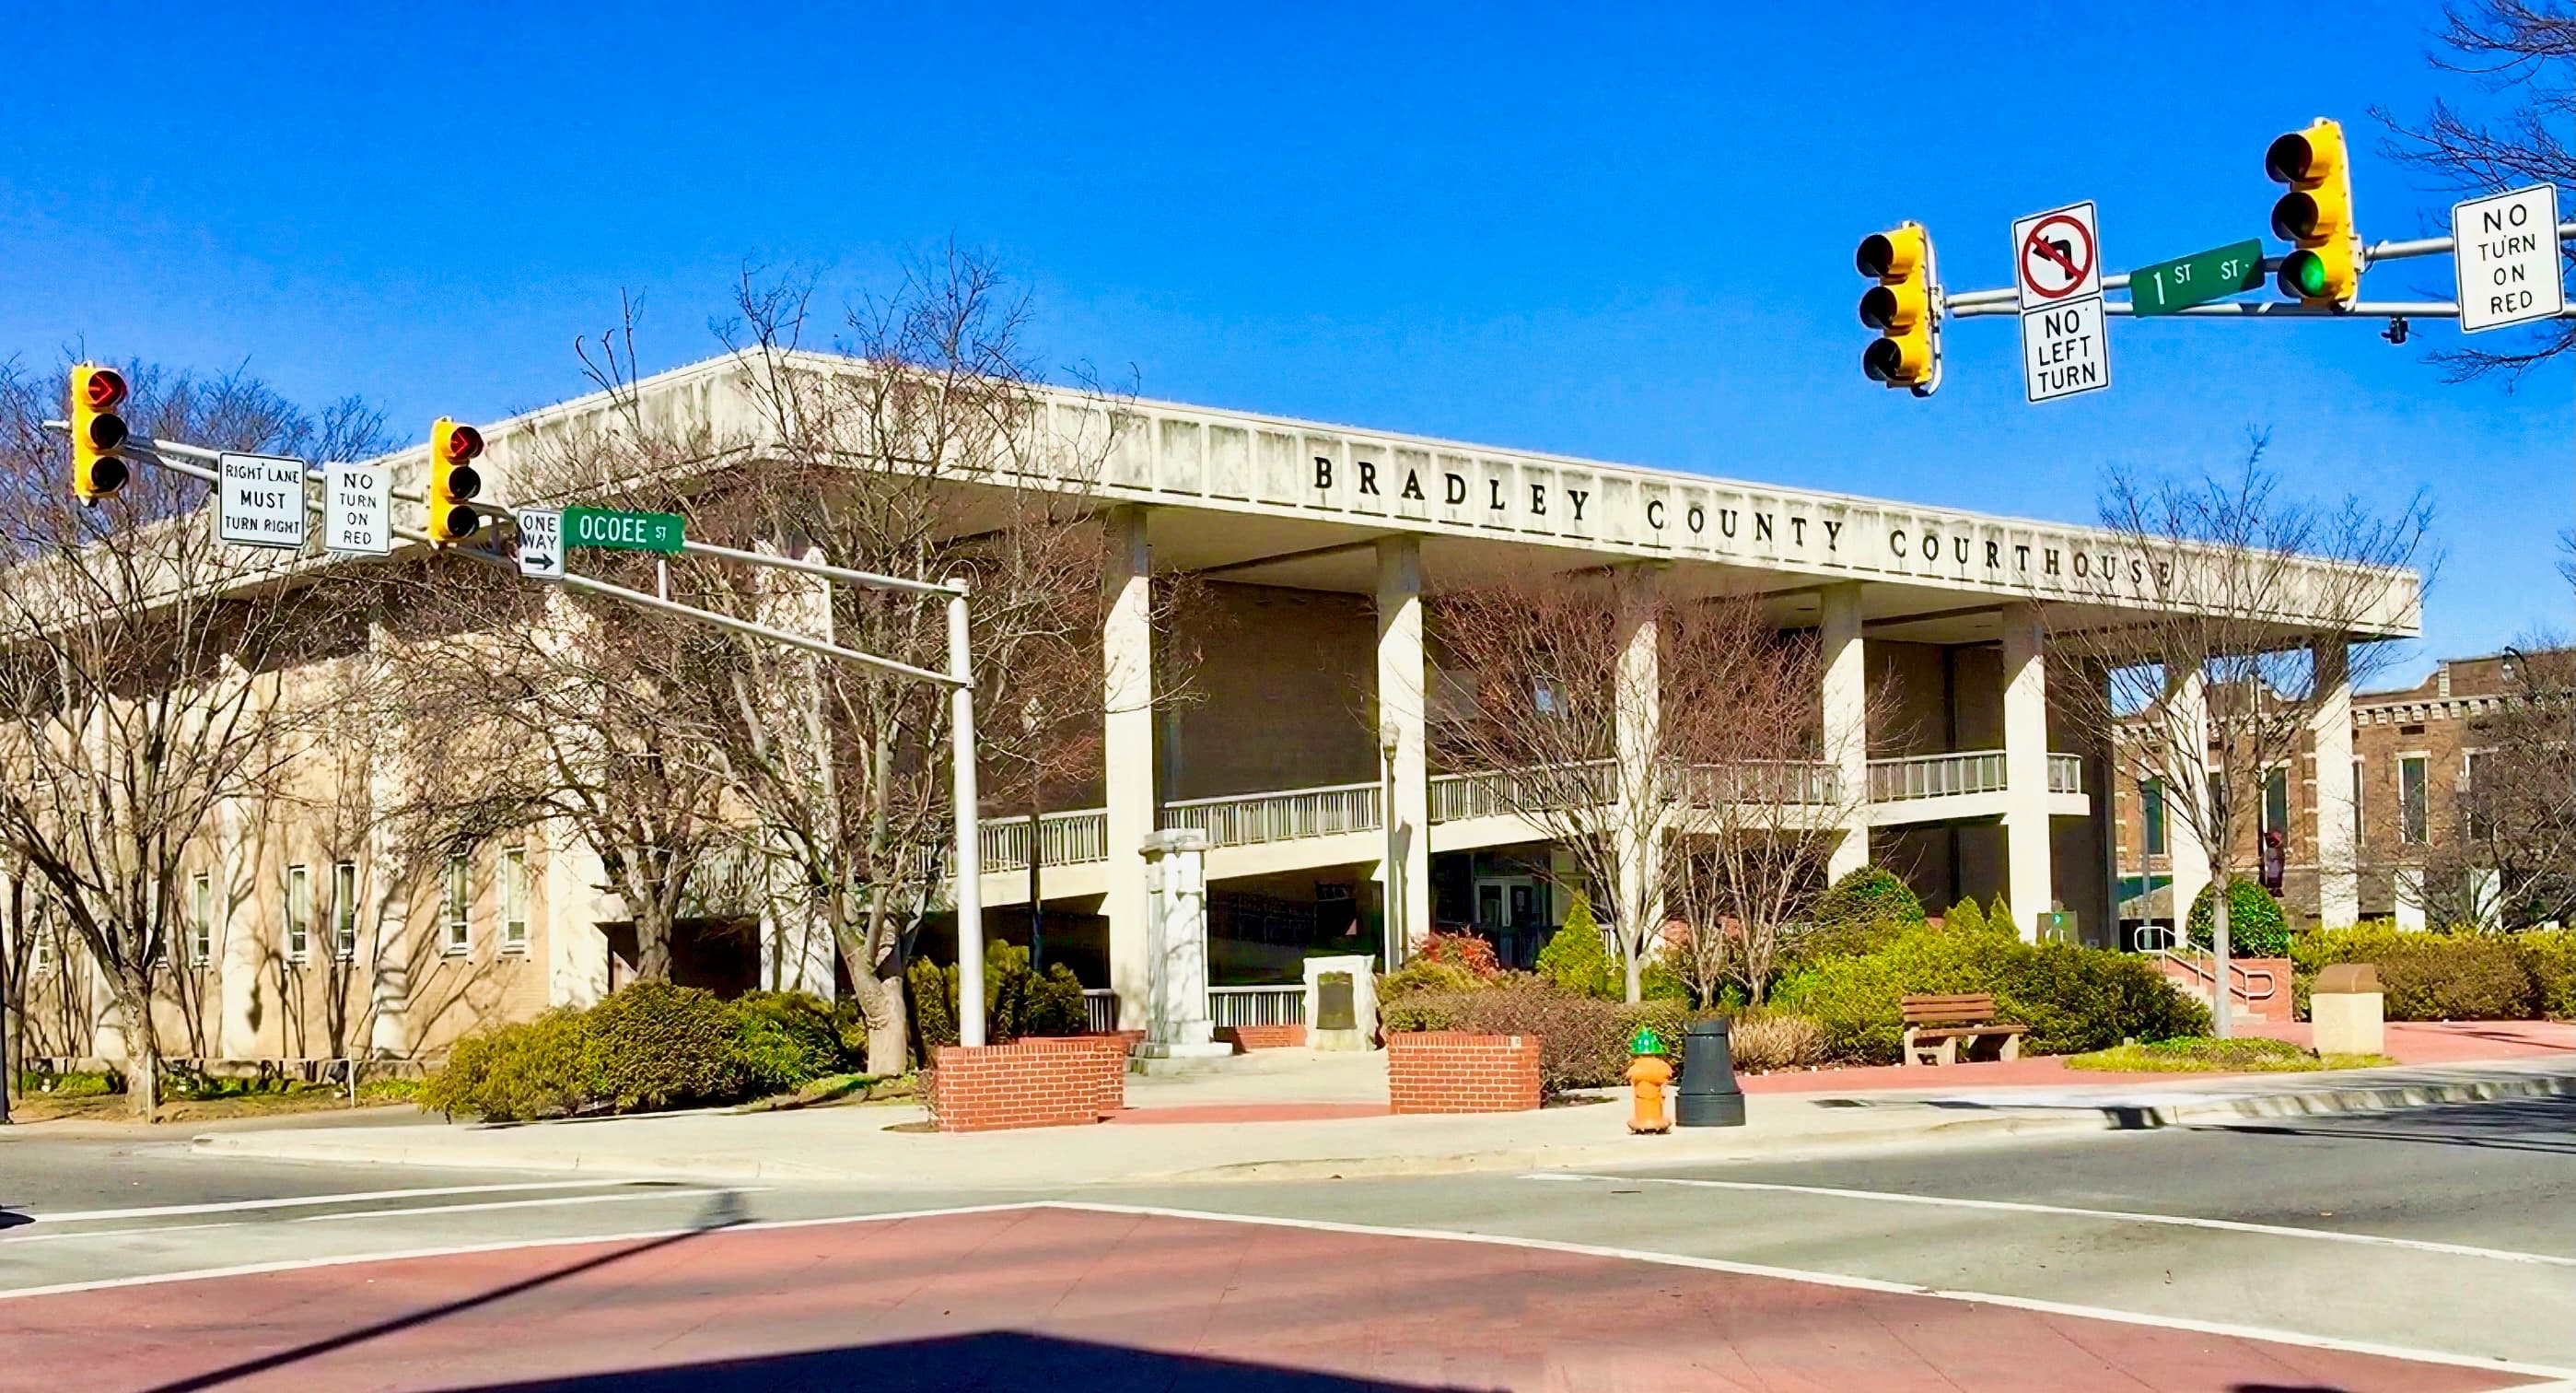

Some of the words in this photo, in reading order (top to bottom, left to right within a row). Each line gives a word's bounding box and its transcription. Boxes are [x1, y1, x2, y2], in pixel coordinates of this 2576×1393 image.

[2484, 204, 2527, 233] NO
[2477, 233, 2535, 262] TURN
[2494, 263, 2525, 286] ON
[2490, 290, 2533, 314] RED
[2045, 310, 2080, 338] NO
[2038, 335, 2091, 367] LEFT
[2038, 362, 2096, 392] TURN
[226, 463, 262, 481] RIGHT
[268, 468, 300, 484] LANE
[344, 473, 373, 490] NO
[240, 489, 286, 509] MUST
[340, 493, 377, 509] TURN
[226, 516, 258, 531] TURN
[264, 519, 300, 534] RIGHT
[347, 512, 368, 526] ON
[523, 515, 556, 533] ONE
[579, 515, 647, 544] OCOEE
[655, 526, 667, 541] ST
[1313, 456, 1590, 520] BRADLEY
[1647, 499, 1843, 552] COUNTY
[1889, 530, 2173, 588] COURTHOUSE
[344, 531, 372, 544] RED
[520, 533, 557, 550] WAY
